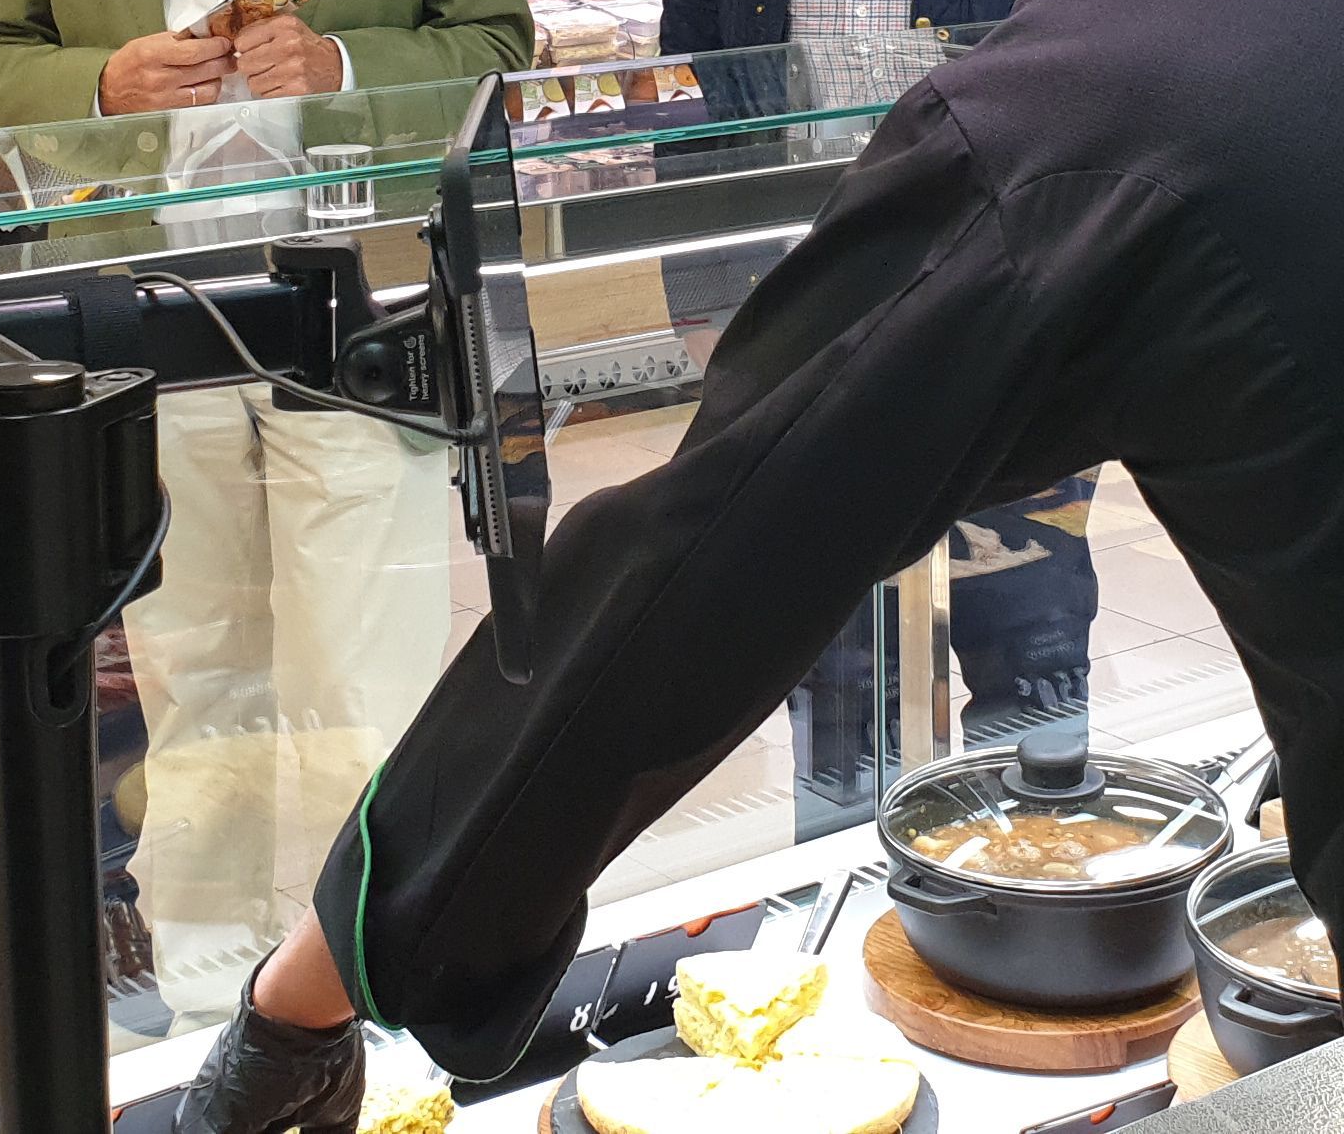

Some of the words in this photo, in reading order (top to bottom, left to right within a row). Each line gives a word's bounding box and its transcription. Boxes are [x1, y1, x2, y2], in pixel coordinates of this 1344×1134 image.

[406, 351, 415, 365] for
[418, 334, 427, 371] screens
[408, 366, 419, 402] Tighten
[421, 373, 430, 401] heavy
